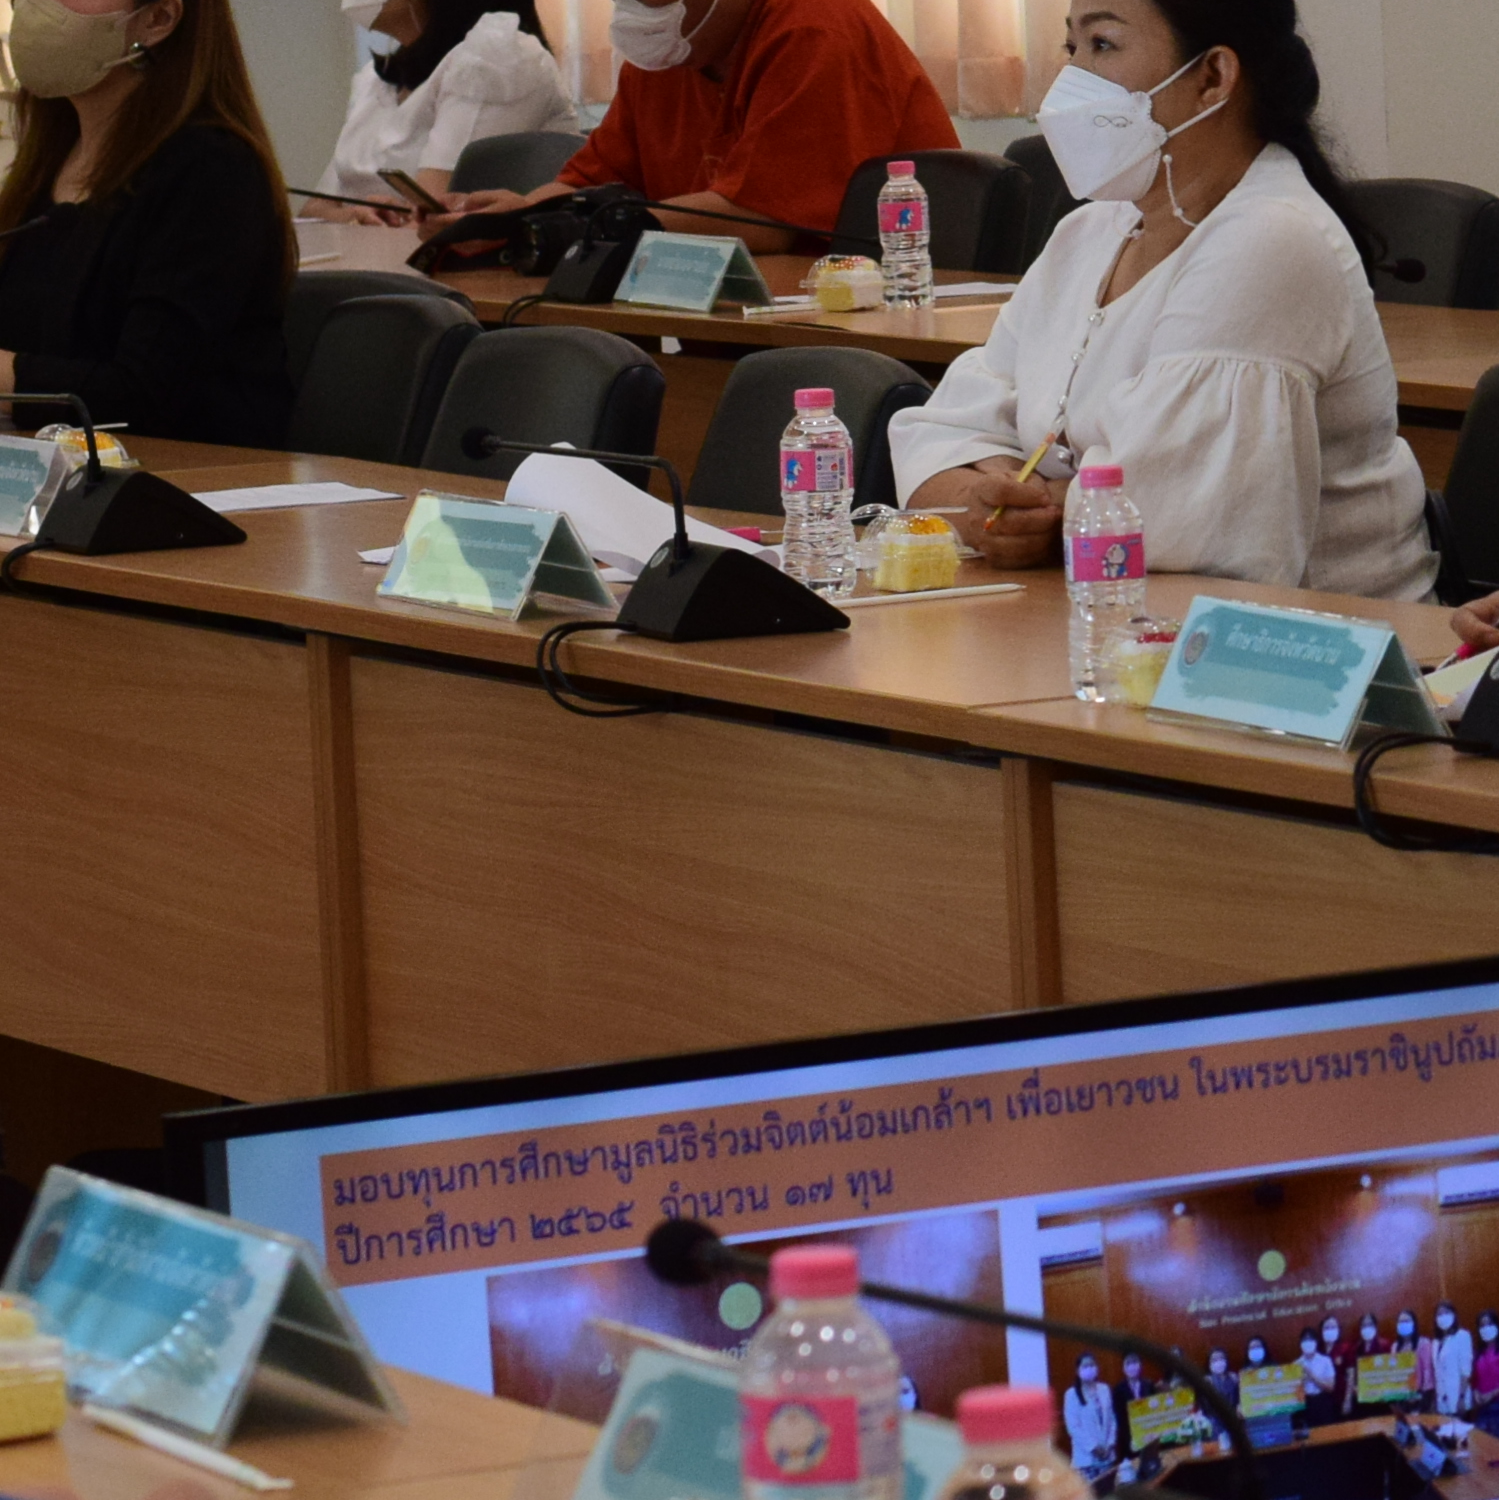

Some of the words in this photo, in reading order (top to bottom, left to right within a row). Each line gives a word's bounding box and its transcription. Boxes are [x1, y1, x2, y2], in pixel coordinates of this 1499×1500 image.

[334, 1086, 993, 1207] มอบทุนการศึกษามูลนิธิร่วมจิตต์น้อมเกล้าฯ
[1006, 1069, 1179, 1121] เพื่อเยาวชน
[336, 1212, 515, 1266] ปีการศึกษา
[529, 1201, 633, 1240] ๒๕๖๕
[660, 1181, 769, 1221] จำนวน
[784, 1174, 834, 1206] ๑๗
[847, 1167, 893, 1210] ทุน
